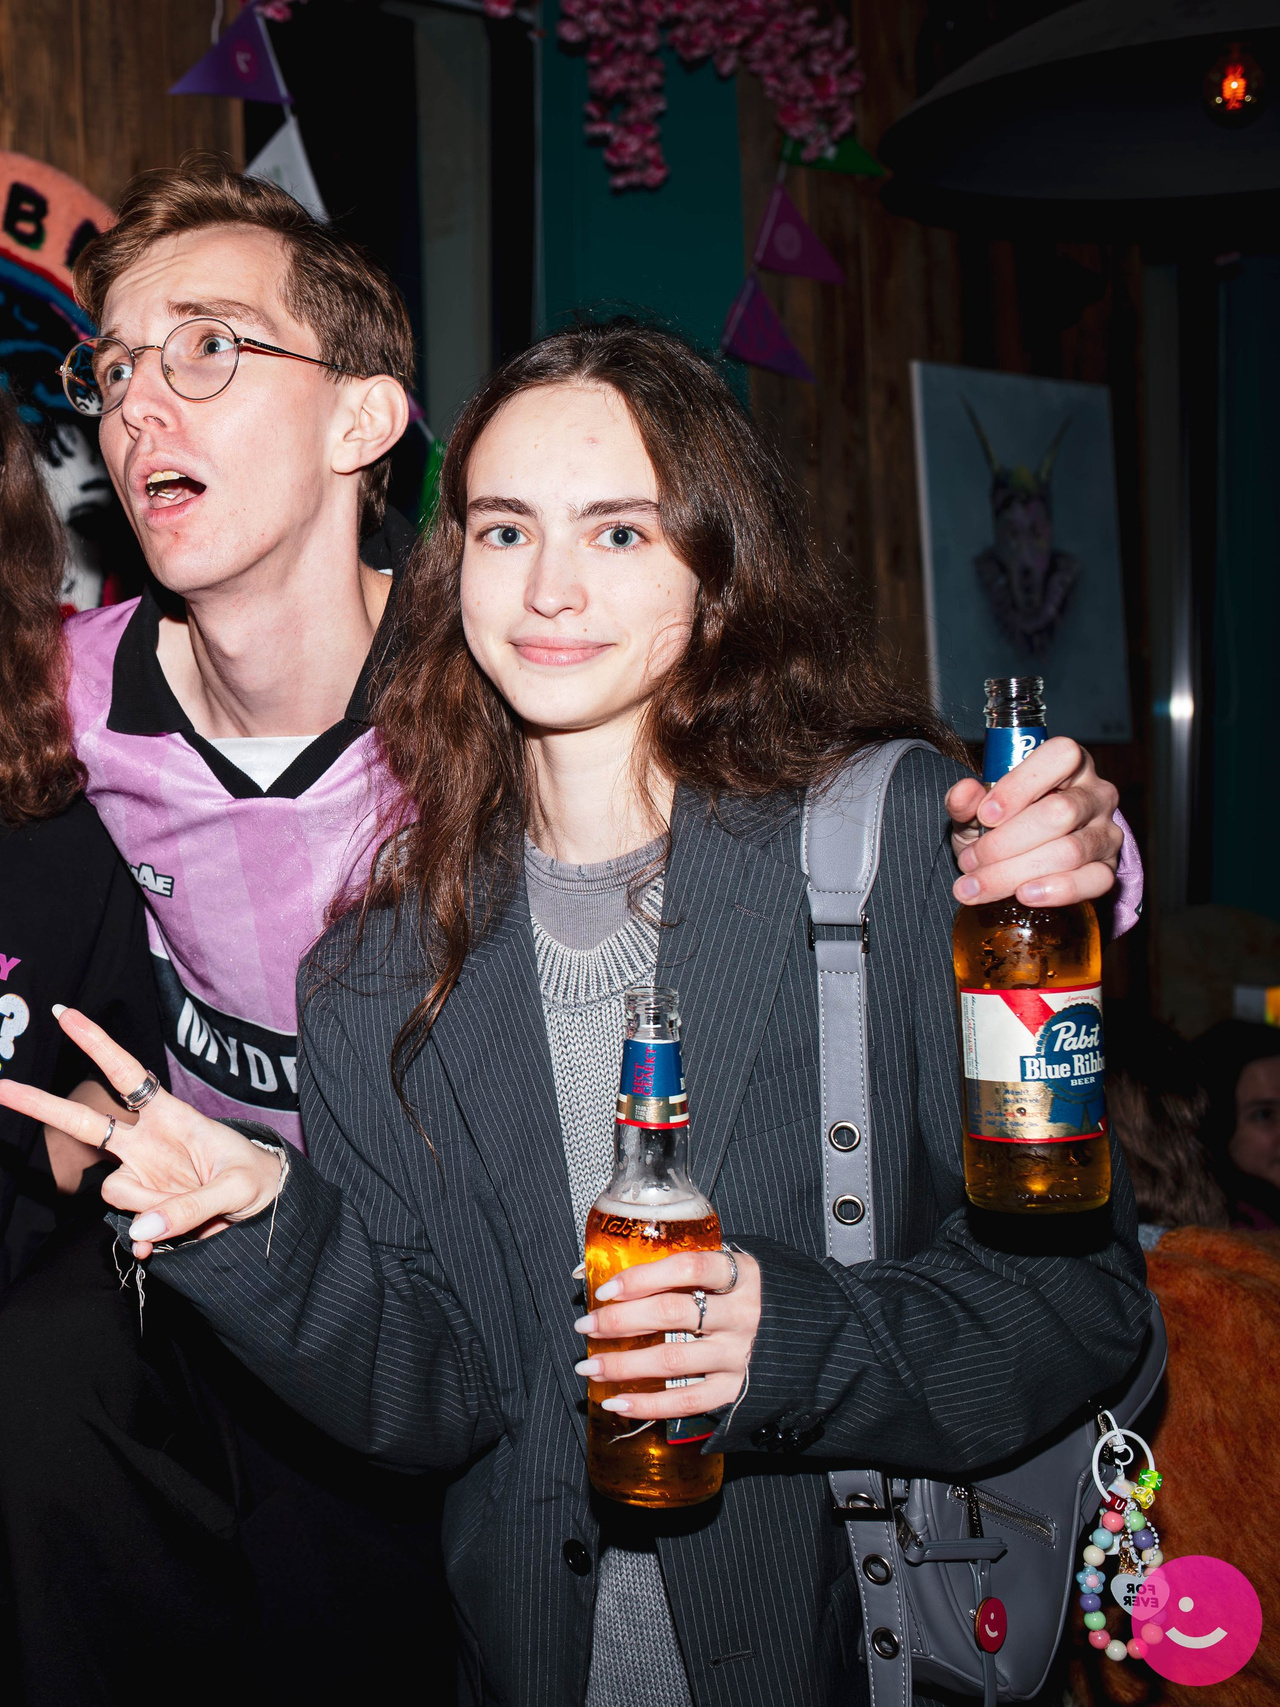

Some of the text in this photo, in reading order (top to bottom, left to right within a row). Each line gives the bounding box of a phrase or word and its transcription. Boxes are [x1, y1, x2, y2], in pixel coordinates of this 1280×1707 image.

[3, 183, 48, 249] В
[1051, 1021, 1100, 1052] Pabst
[632, 1063, 646, 1094] БЕСТ
[1023, 1051, 1105, 1080] Blue Ribb
[1070, 1076, 1096, 1087] BEER
